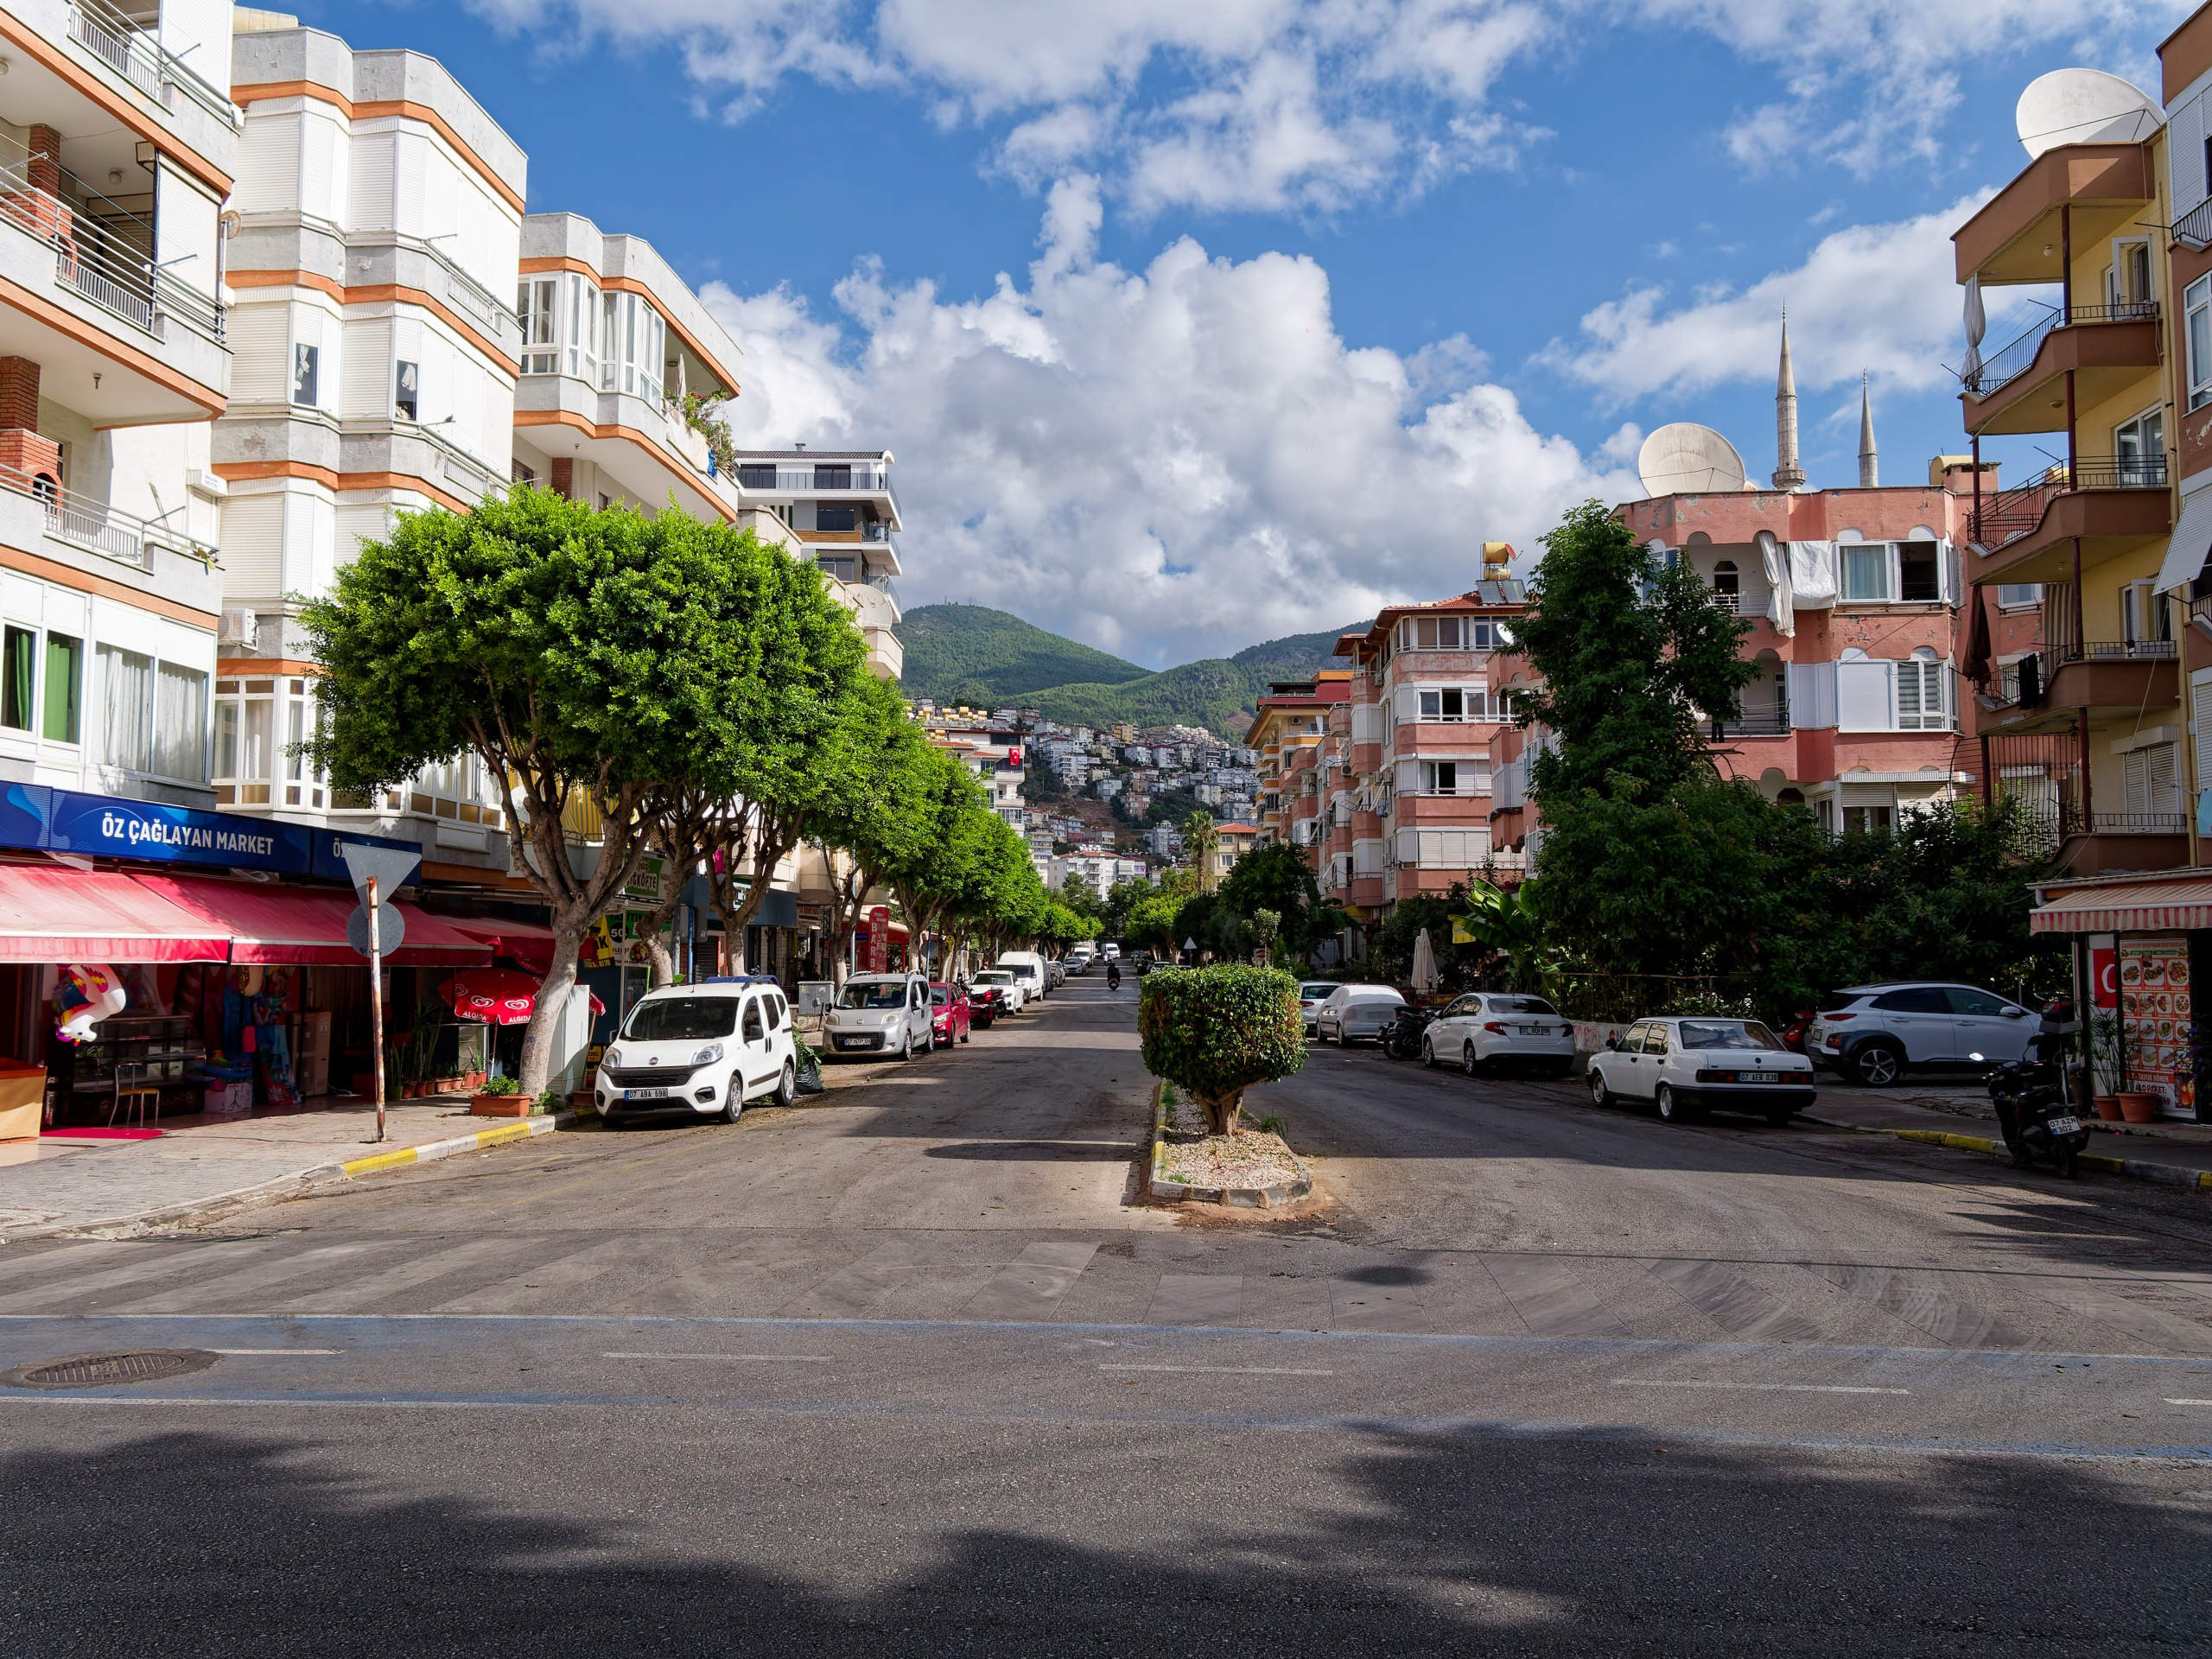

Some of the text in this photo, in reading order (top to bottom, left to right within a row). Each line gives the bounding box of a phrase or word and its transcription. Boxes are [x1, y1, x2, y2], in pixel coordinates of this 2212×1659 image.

[102, 812, 274, 855] ÖZ ÇAĞLAYAN MARKET
[462, 1011, 488, 1021] ALGIDA
